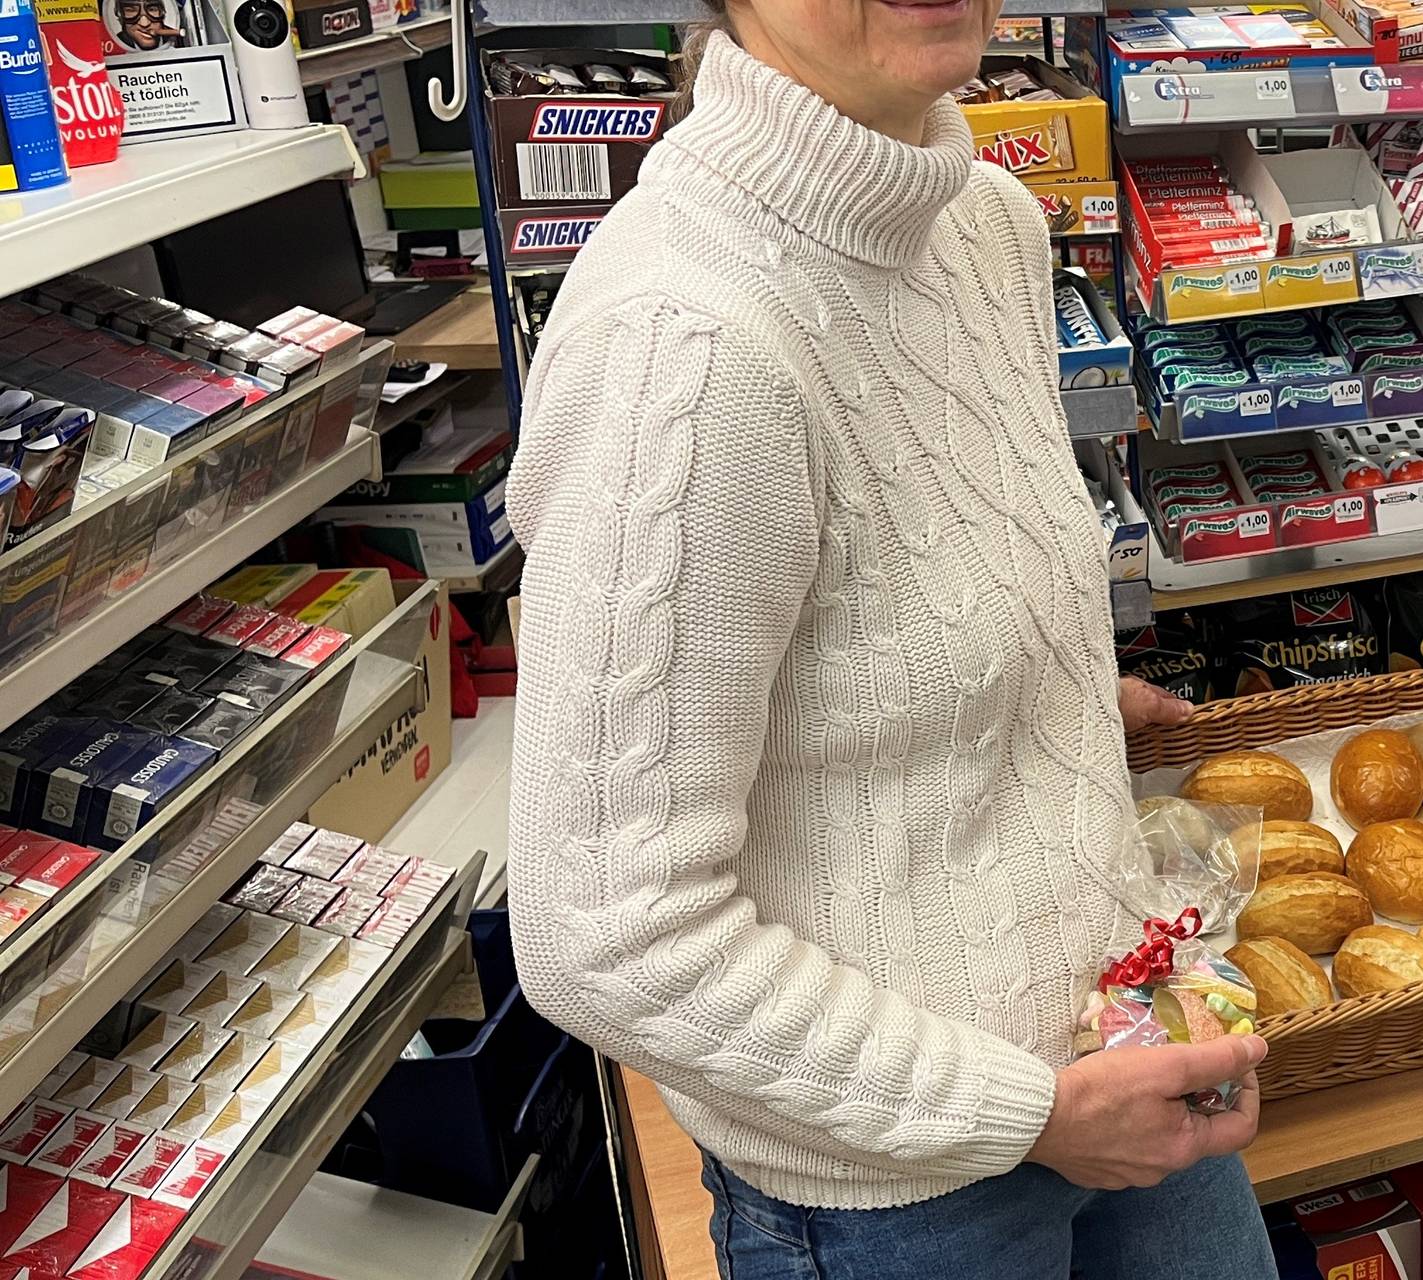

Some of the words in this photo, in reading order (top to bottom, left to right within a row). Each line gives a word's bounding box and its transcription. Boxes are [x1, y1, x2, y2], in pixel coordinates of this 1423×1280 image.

[0, 51, 42, 69] Burton
[118, 71, 183, 88] Rauchen
[1364, 74, 1403, 87] Extra
[140, 86, 189, 100] tödlich
[1160, 82, 1200, 97] Extra
[537, 109, 657, 136] SNICKERS
[62, 125, 121, 142] VOLUM
[973, 131, 1050, 169] wix
[1171, 202, 1225, 212] Pfefferminz
[518, 221, 603, 248] SNICKE
[1268, 264, 1318, 281] Airwaves
[1361, 255, 1415, 274] Airwaves
[1171, 275, 1224, 291] Airwaves
[1153, 346, 1226, 366] Airwaves
[1175, 371, 1248, 390] Airwaves
[1373, 377, 1423, 394] Airwaves
[1279, 386, 1331, 405] Airwaves
[1183, 397, 1238, 414] Airwaves
[1250, 472, 1316, 490] Airwaves
[1158, 484, 1230, 502] Airwaves
[1282, 505, 1332, 522] Airwaves
[1183, 520, 1237, 537] Airwaves
[301, 635, 334, 656] Burton
[1263, 632, 1377, 669] Chipsfrisc
[1299, 1194, 1340, 1213] West
